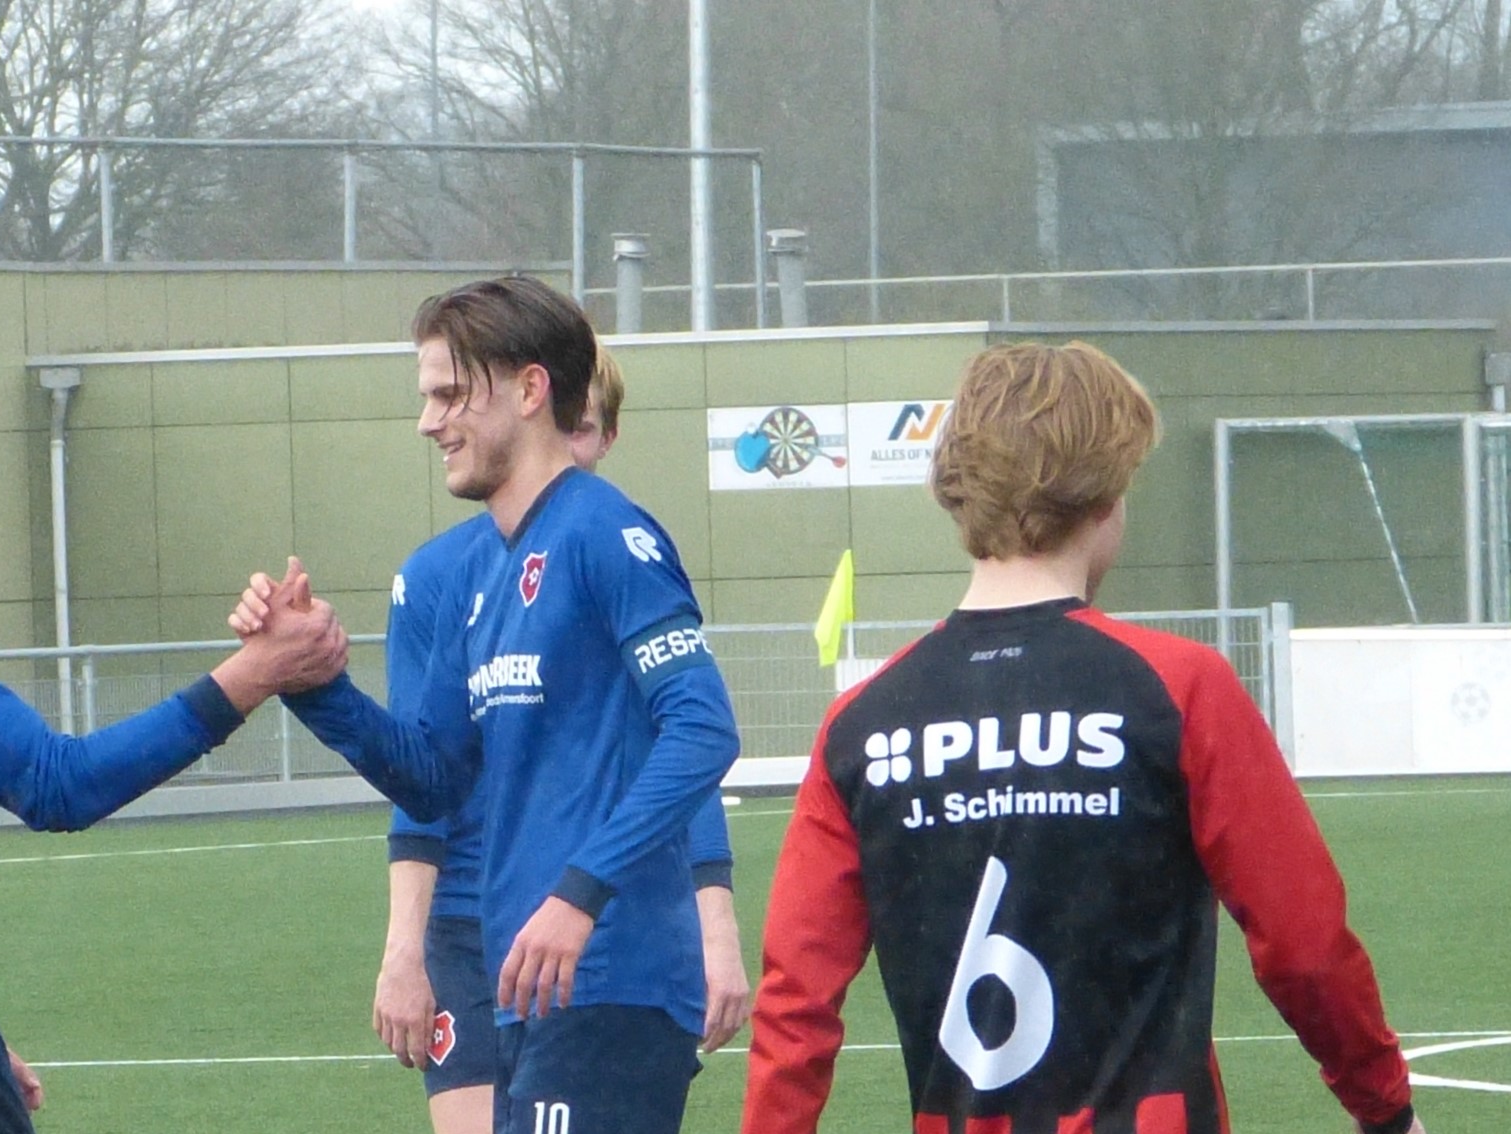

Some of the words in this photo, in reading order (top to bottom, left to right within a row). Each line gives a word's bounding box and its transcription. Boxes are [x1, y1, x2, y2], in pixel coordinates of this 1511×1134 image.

[871, 448, 906, 461] ALLES
[907, 448, 922, 460] OF
[922, 711, 1125, 777] PLUS
[903, 798, 935, 829] J.
[944, 785, 1120, 822] Schimmel
[938, 855, 1055, 1091] 6
